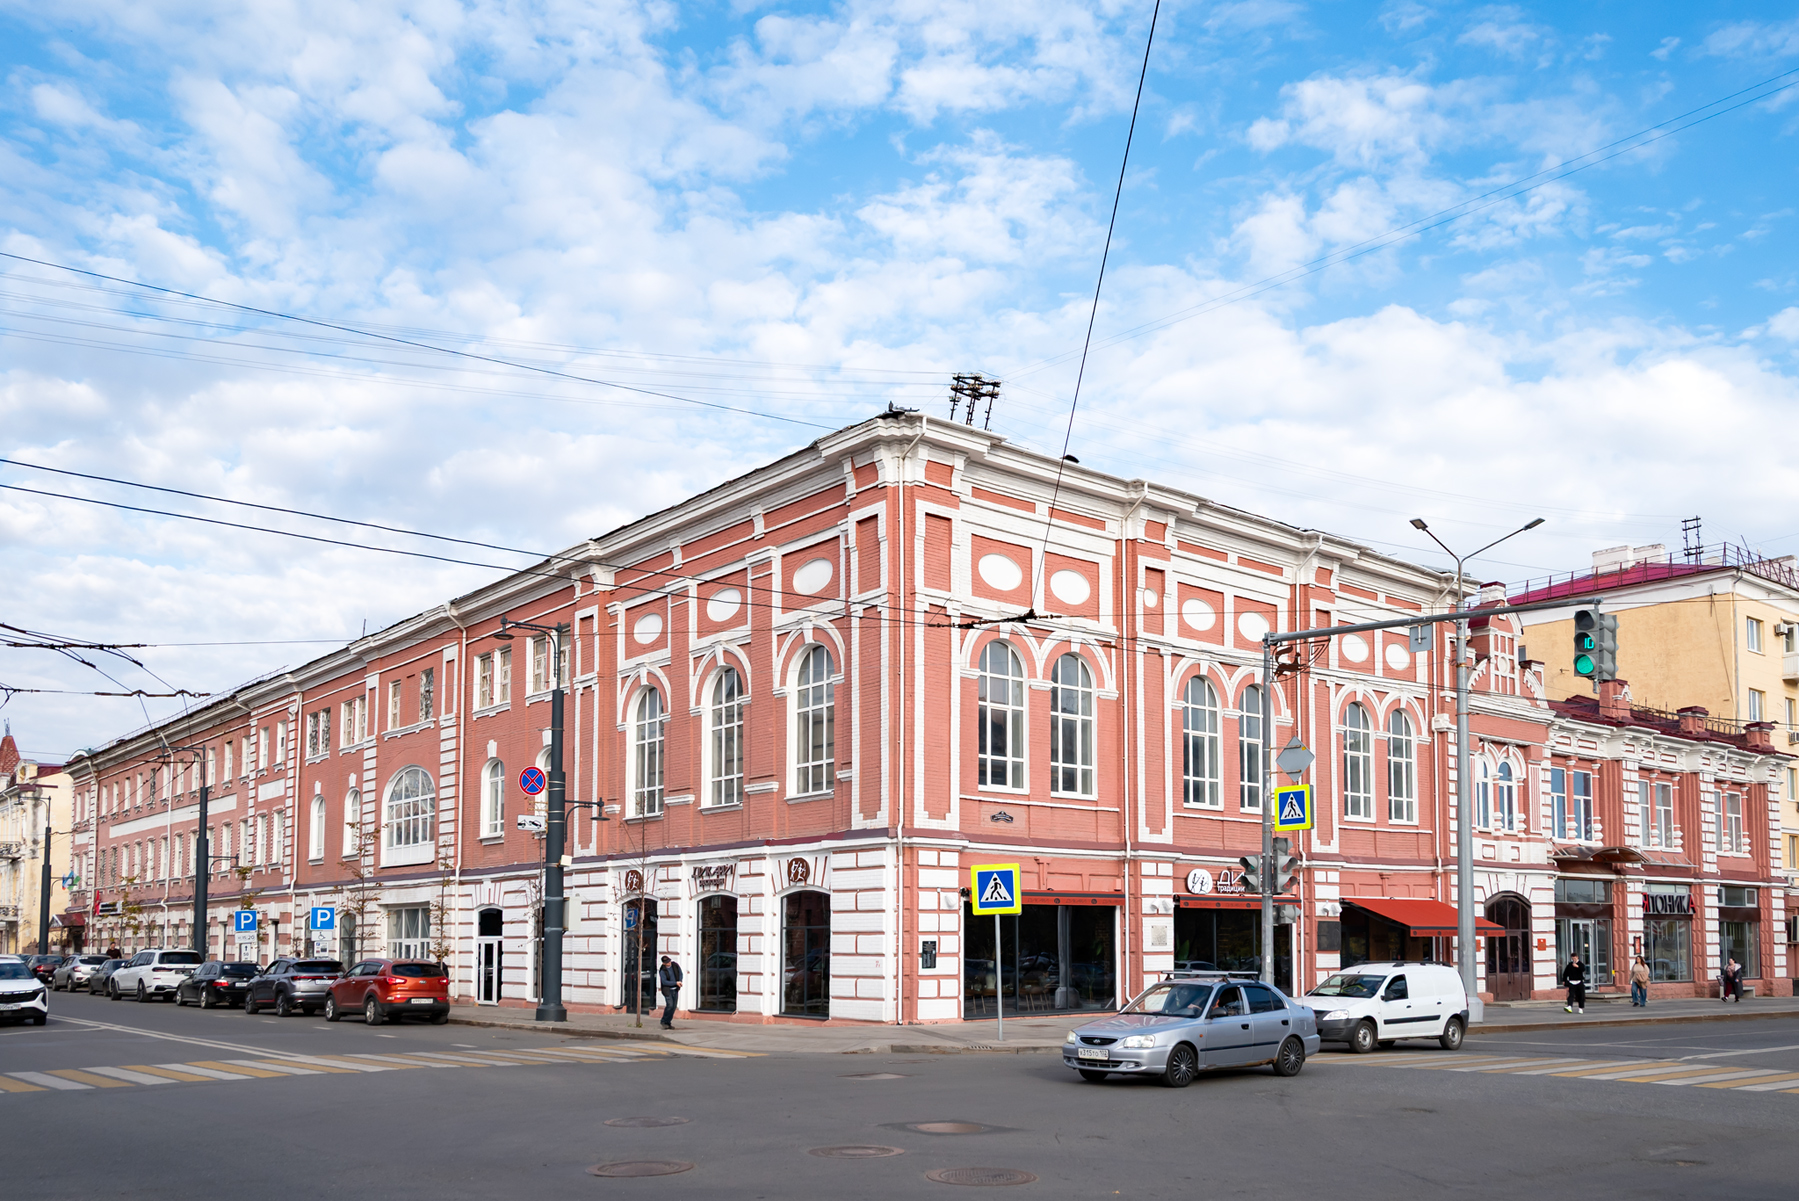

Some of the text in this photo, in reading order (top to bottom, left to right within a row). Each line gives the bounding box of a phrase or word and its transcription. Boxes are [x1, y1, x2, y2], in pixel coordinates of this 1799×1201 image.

[1584, 636, 1595, 649] 10
[1642, 892, 1697, 914] ЯПОНИКА
[241, 913, 253, 929] P
[317, 909, 331, 928] P
